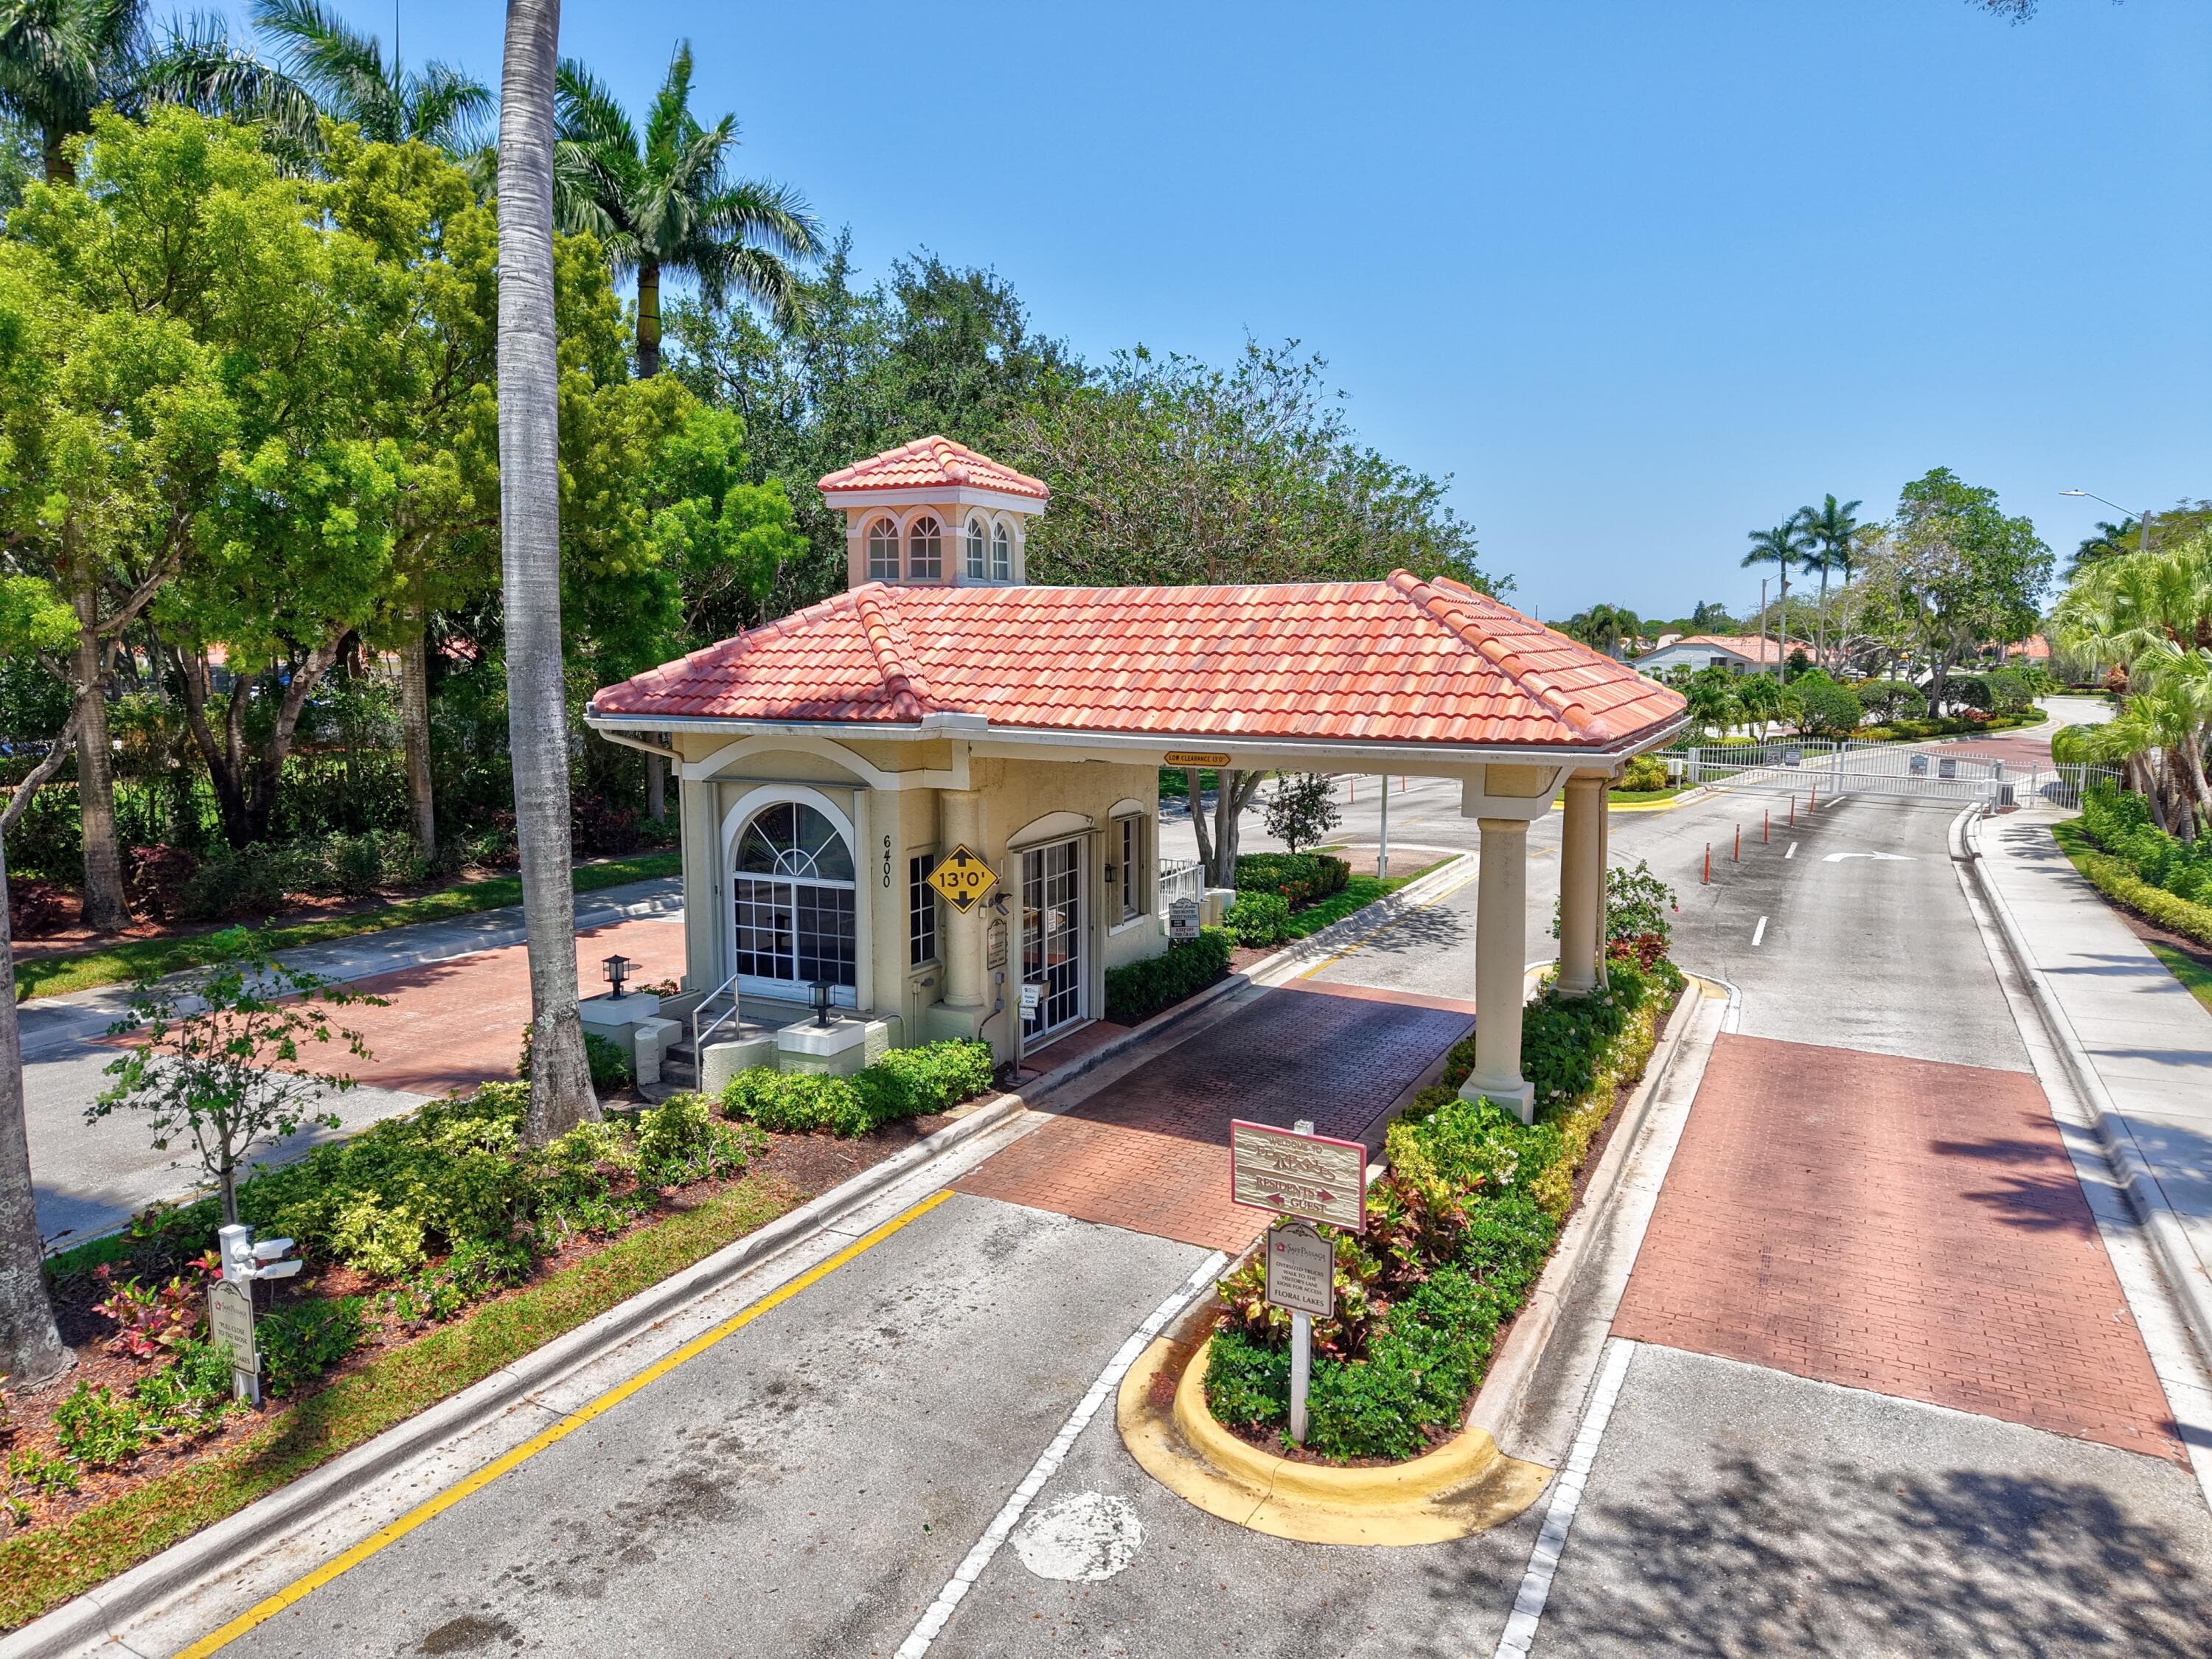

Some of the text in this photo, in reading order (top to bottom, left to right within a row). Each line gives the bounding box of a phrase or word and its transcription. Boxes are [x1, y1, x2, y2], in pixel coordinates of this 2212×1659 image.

[883, 835, 891, 888] 6400
[1268, 1135, 1324, 1155] WELCOME TO
[1256, 1176, 1315, 1196] RESIDENTS
[1290, 1197, 1327, 1212] GUEST
[1276, 1262, 1324, 1277] OVERSIZED TRUCKS
[1274, 1289, 1324, 1307] FLORAL LAKES
[1304, 1287, 1322, 1295] ACCESS
[225, 1332, 233, 1340] THE
[234, 1335, 248, 1344] KIOSK
[232, 1326, 244, 1335] CLOSE
[236, 1354, 251, 1365] LAKES
